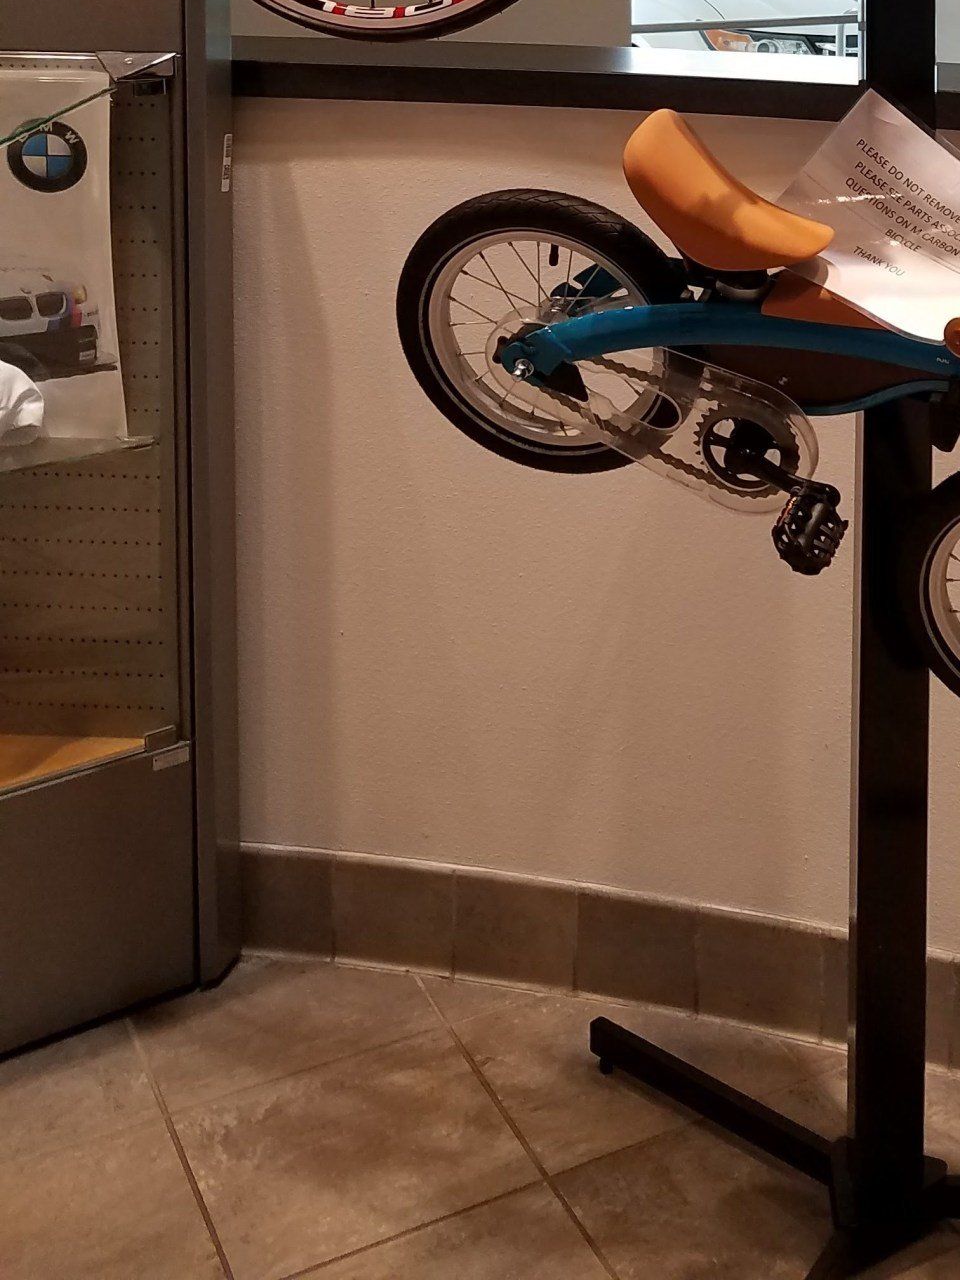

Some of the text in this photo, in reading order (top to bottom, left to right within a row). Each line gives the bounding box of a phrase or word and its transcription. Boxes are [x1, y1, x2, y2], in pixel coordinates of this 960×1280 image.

[856, 138, 890, 169] PLEASE
[887, 165, 904, 180] DO
[903, 178, 925, 196] NOT
[855, 161, 888, 191] PLEASE
[902, 200, 933, 223] PARTS
[885, 228, 922, 252] BICYCLE
[895, 215, 912, 229] ON
[909, 225, 923, 235] M
[921, 232, 960, 257] CARBON
[853, 245, 906, 277] THANK YOU
